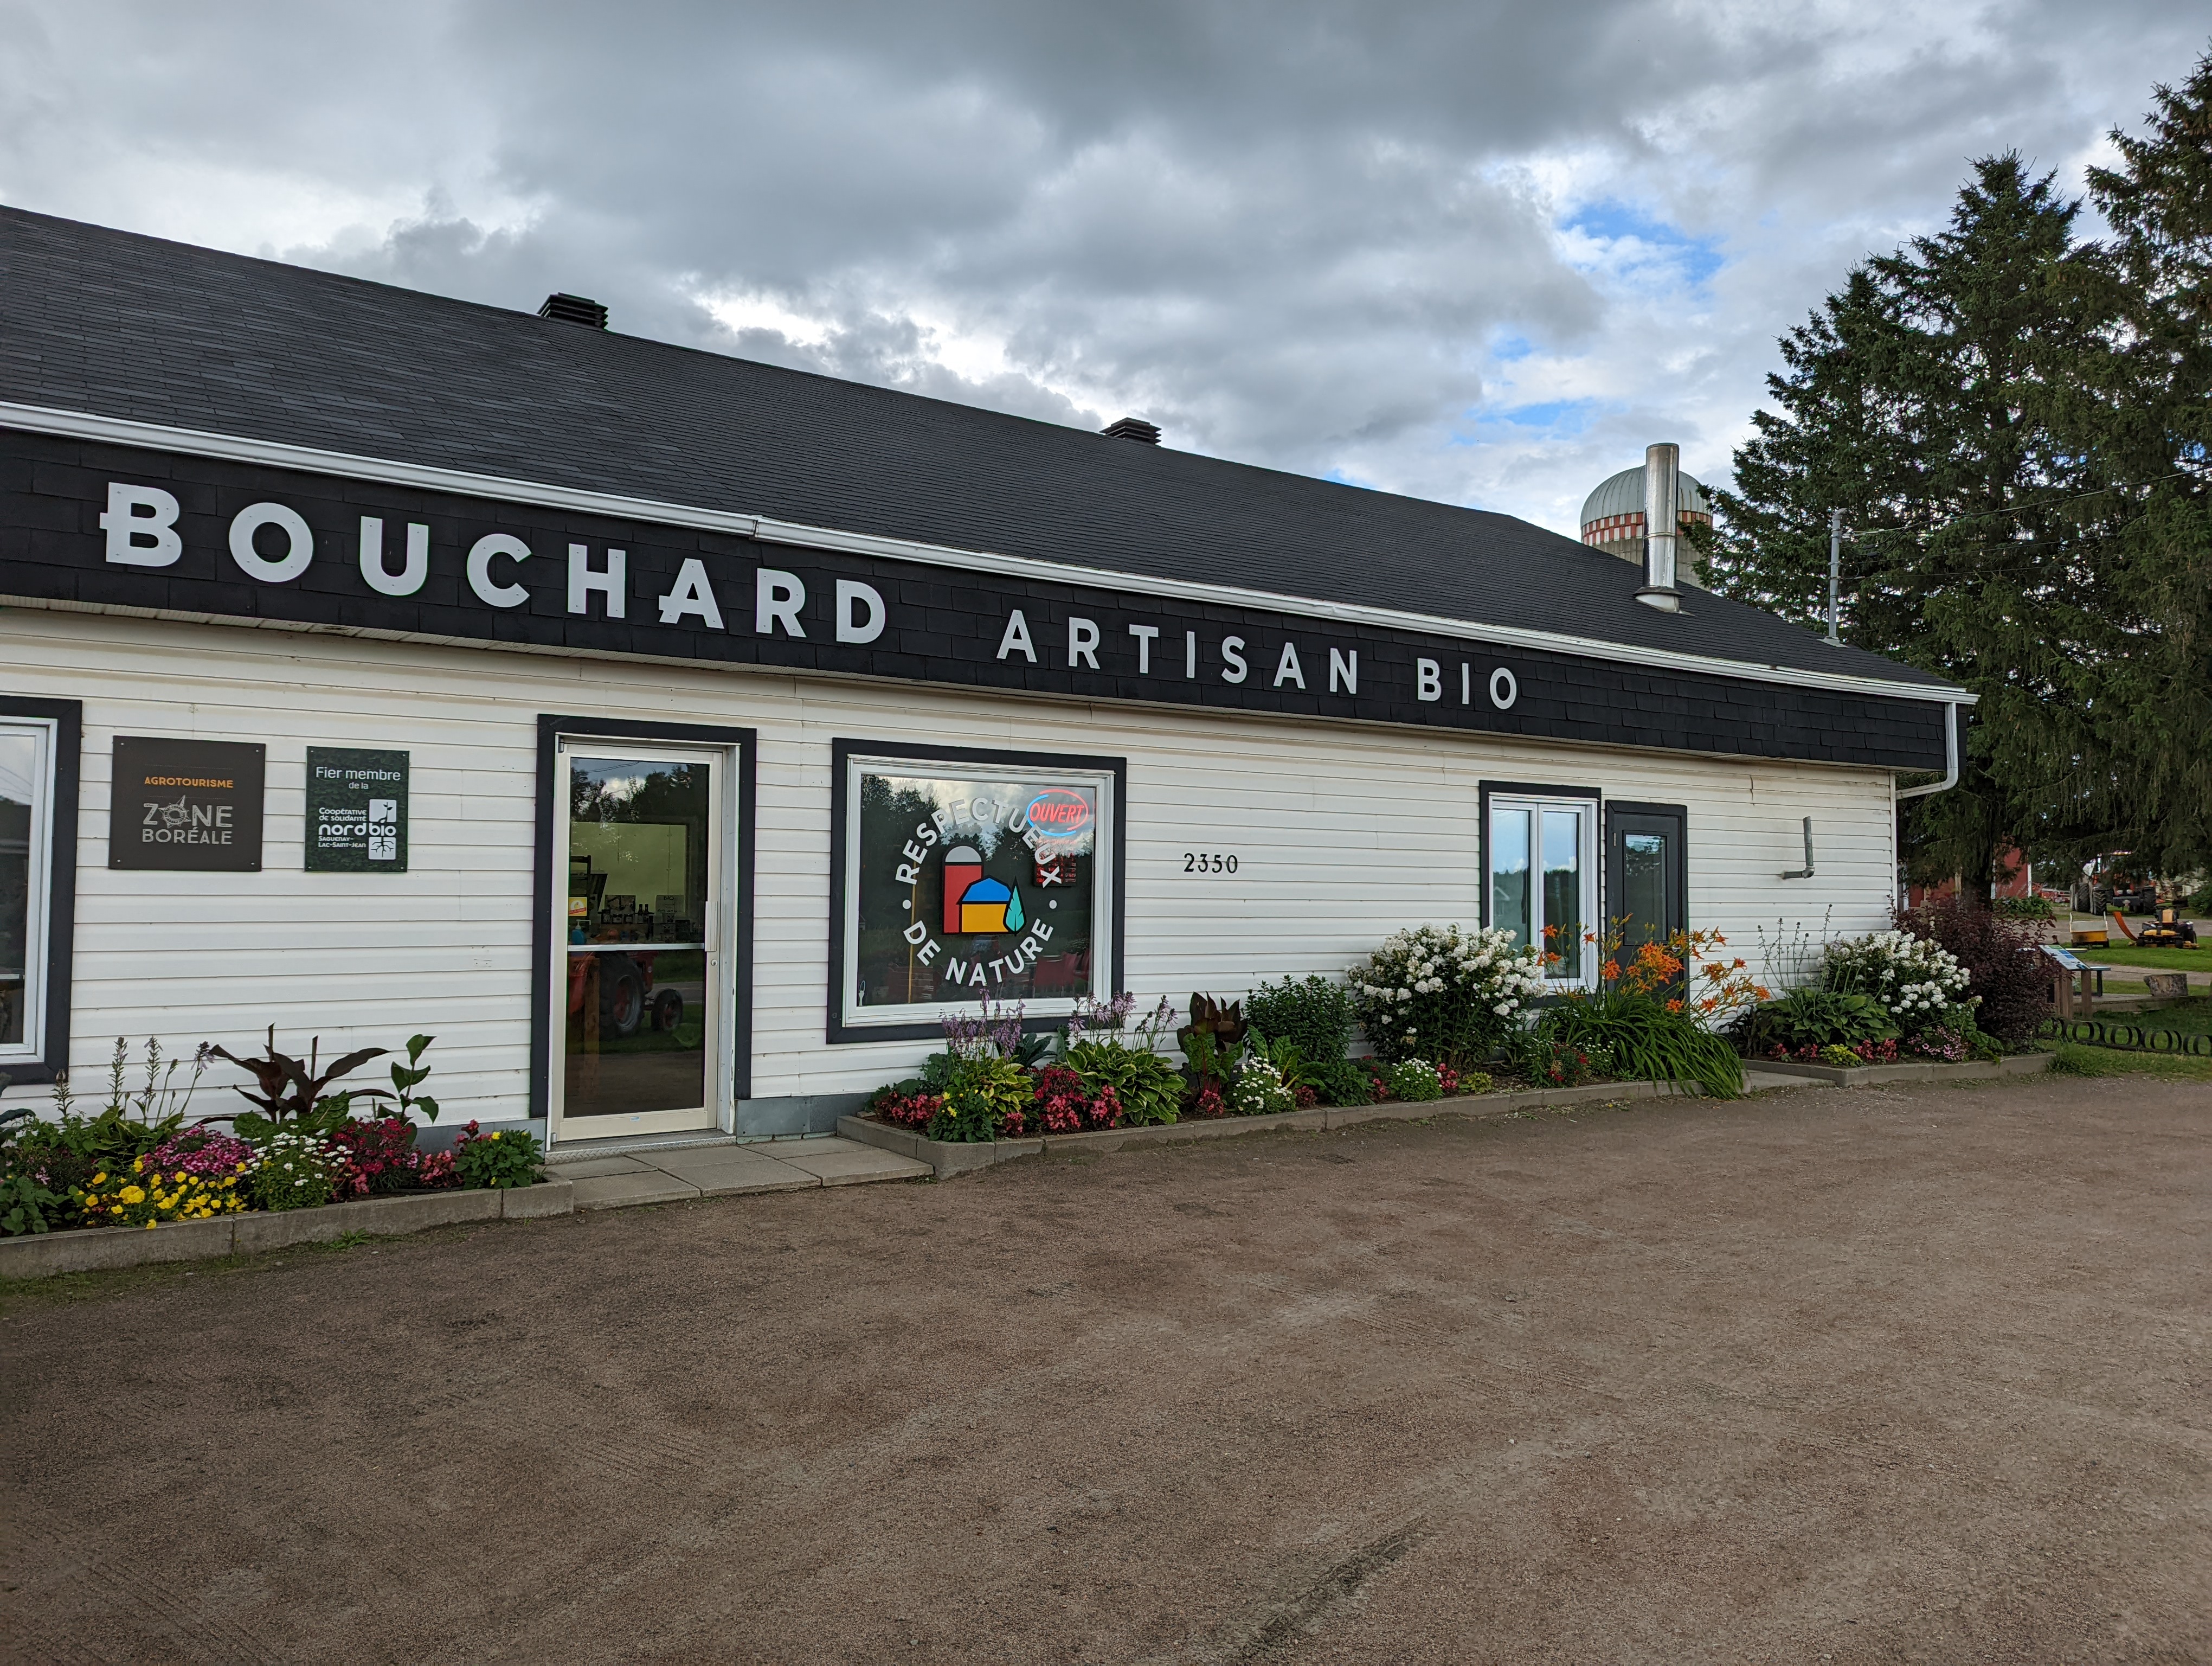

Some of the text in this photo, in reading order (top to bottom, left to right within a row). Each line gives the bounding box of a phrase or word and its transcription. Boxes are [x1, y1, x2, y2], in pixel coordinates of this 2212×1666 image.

[100, 482, 1517, 710] BOUCHARD ARTISAN BIO
[144, 776, 234, 789] AGROTOURISME
[316, 766, 401, 781] Fier membre
[143, 803, 234, 828] ZONE
[1030, 803, 1084, 823] OUVERT
[142, 827, 233, 845] BORÉALE
[895, 797, 1062, 888] RESPECTUEUX
[1184, 853, 1238, 874] 2350
[903, 918, 1054, 986] DE NATURE
